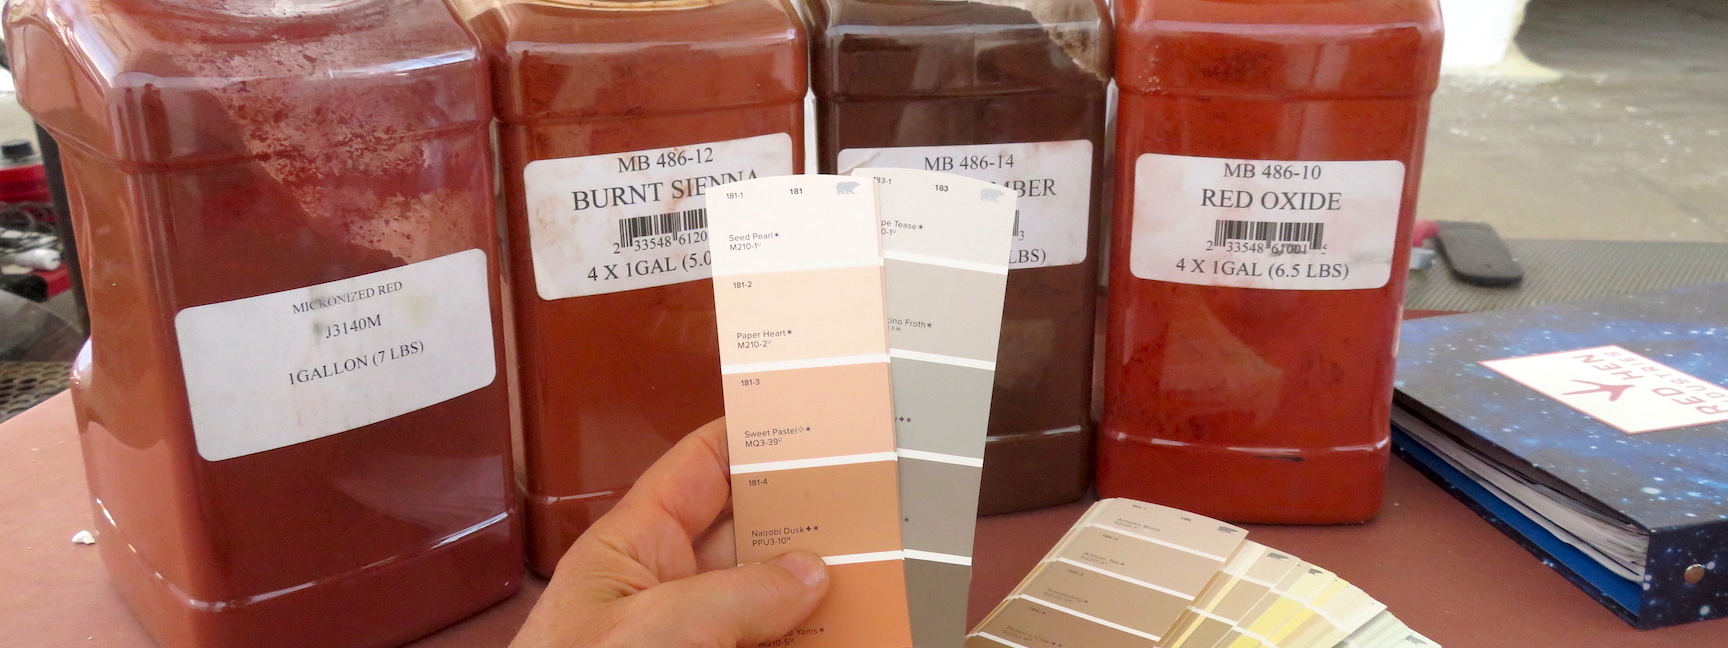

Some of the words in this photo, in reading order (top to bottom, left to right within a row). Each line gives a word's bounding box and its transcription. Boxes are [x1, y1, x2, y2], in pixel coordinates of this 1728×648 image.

[617, 154, 651, 173] MB
[656, 147, 714, 168] 486-12
[924, 156, 954, 172] MB
[959, 153, 1015, 170] 486-14
[1222, 162, 1256, 179] MB
[1261, 164, 1322, 181] 486-10
[571, 181, 664, 211] BURNT
[935, 184, 949, 192] 183
[1200, 188, 1253, 209] RED
[1261, 191, 1343, 211] OXIDE
[894, 220, 917, 230] Tease
[613, 242, 621, 255] 2
[634, 235, 672, 252] 33548
[728, 233, 750, 242] Seed
[752, 231, 773, 240] Pearl
[1018, 230, 1025, 241] 3
[1206, 240, 1214, 251] 2
[1226, 241, 1264, 253] 33548
[587, 266, 598, 282] 4
[603, 264, 619, 281] X
[627, 256, 677, 278] 1GAL
[1176, 258, 1186, 272] 4
[1190, 259, 1205, 273] X
[1213, 260, 1262, 277] 1GAL
[1268, 262, 1300, 281] (6.5
[1306, 263, 1349, 280] LBS)
[733, 280, 753, 289] 181-2
[292, 288, 376, 315] MICRONIZED
[377, 281, 403, 297] RED
[325, 313, 382, 339] J3140M
[904, 318, 926, 328] Froth
[736, 332, 761, 340] Paper
[763, 330, 786, 338] Heart
[288, 354, 369, 386] 1GALLON
[372, 349, 387, 368] (7
[390, 340, 425, 360] LBS)
[1572, 354, 1645, 380] HEN
[741, 378, 760, 387] 181-3
[1604, 351, 1728, 402] DUSTRIES
[1652, 387, 1728, 415] RED
[744, 429, 771, 438] Sweet
[772, 426, 798, 436] Pastel
[748, 478, 768, 487] 181-4
[751, 528, 782, 538] Nairobi
[783, 526, 805, 535] Dusk
[796, 628, 818, 636] Yams
